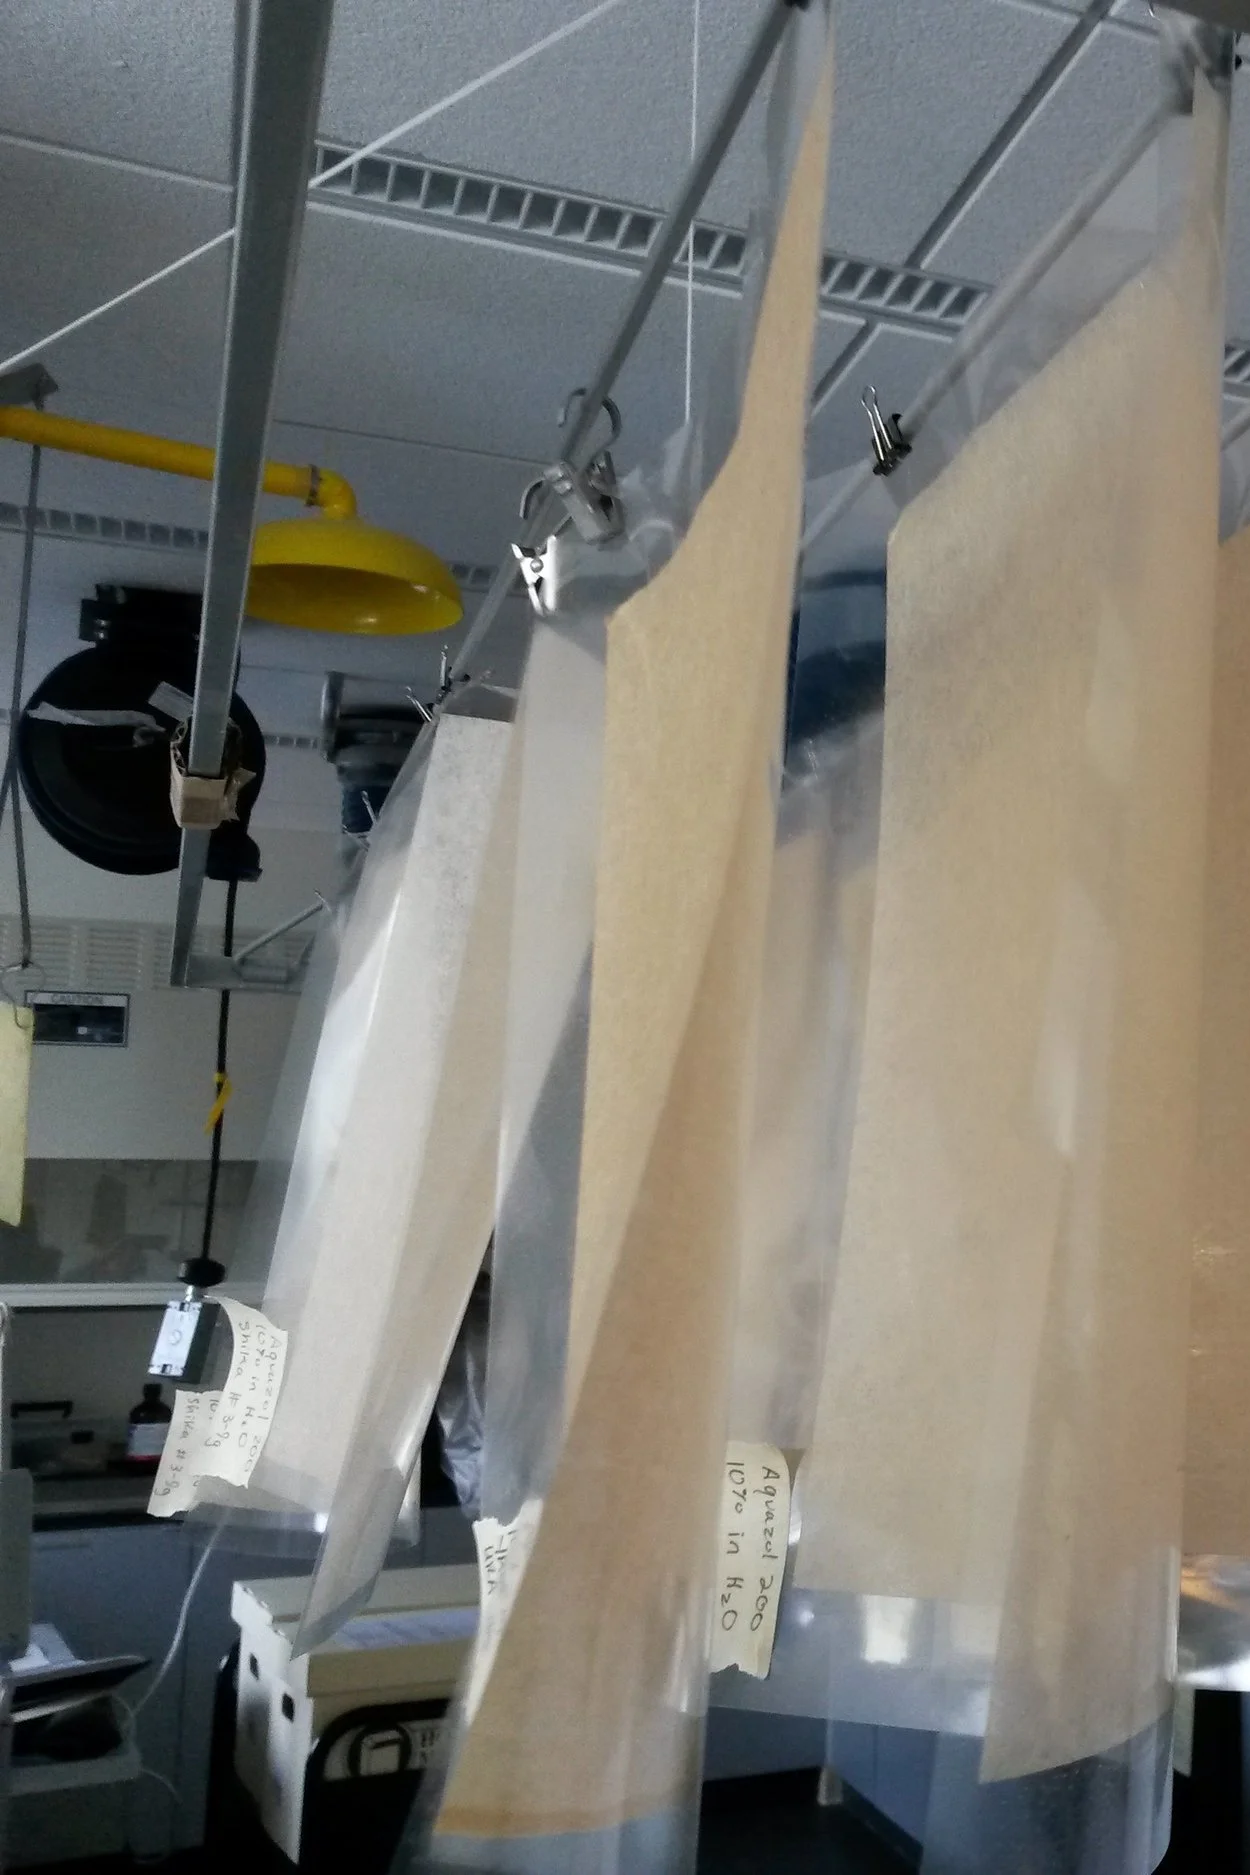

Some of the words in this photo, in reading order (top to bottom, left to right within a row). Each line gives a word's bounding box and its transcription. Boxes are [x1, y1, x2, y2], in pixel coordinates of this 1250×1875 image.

[249, 1375, 261, 1392] in
[258, 1335, 282, 1421] Aquazol
[726, 1461, 748, 1515] 10%
[752, 1465, 781, 1560] Aquazol
[725, 1532, 745, 1555] in
[750, 1574, 775, 1632] 200
